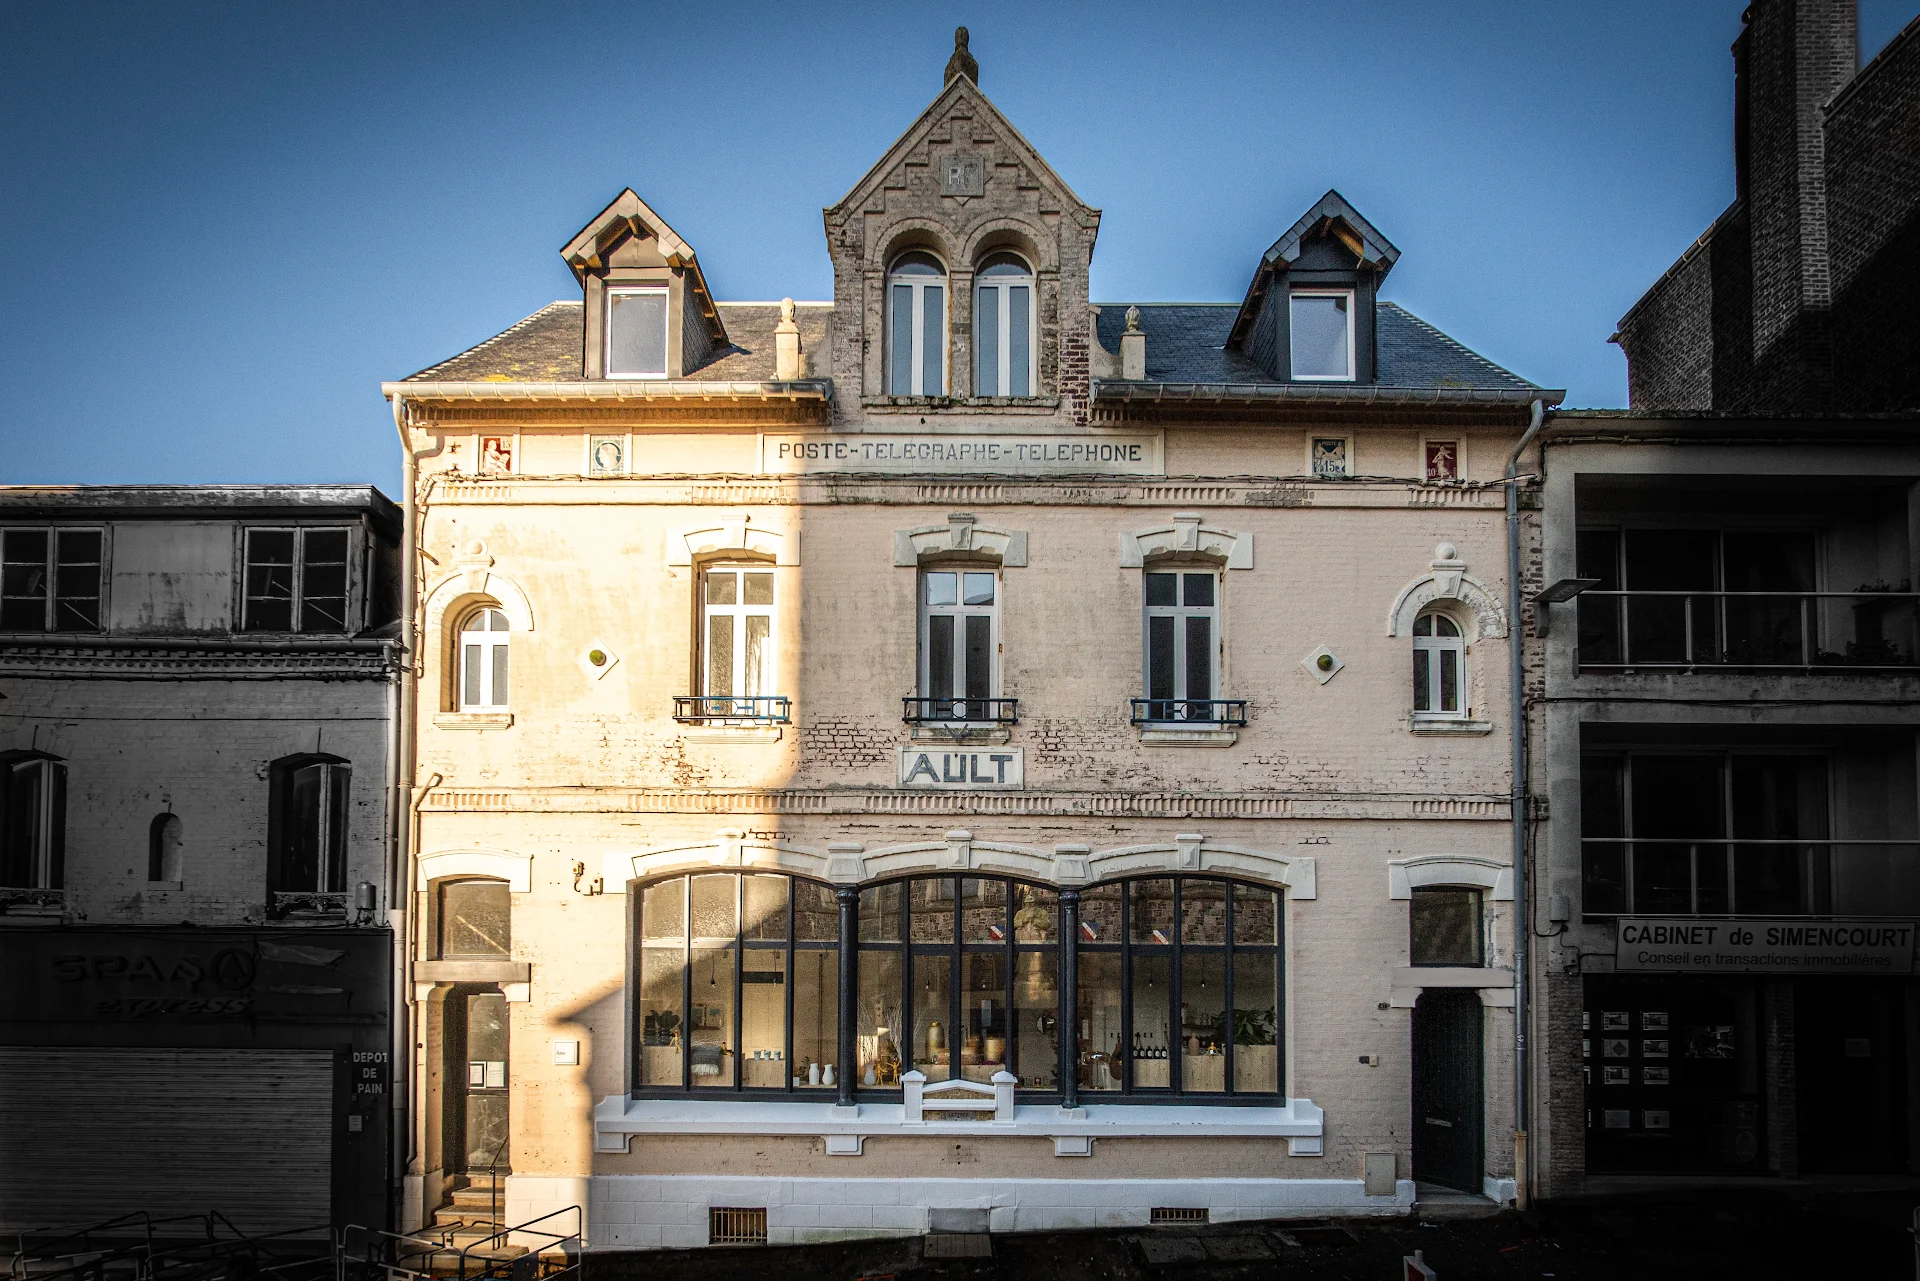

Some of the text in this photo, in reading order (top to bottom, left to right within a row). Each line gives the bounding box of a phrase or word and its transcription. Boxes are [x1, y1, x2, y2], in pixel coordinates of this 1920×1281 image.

[905, 753, 1013, 783] AULT
[1622, 925, 1910, 947] CABINET de SIMENCOURT
[1637, 951, 1892, 967] Conseil en transactions immobilières
[51, 954, 206, 993] SPAR
[352, 1051, 388, 1063] DEPOT
[362, 1067, 377, 1079] DE
[357, 1083, 383, 1094] PAIN
